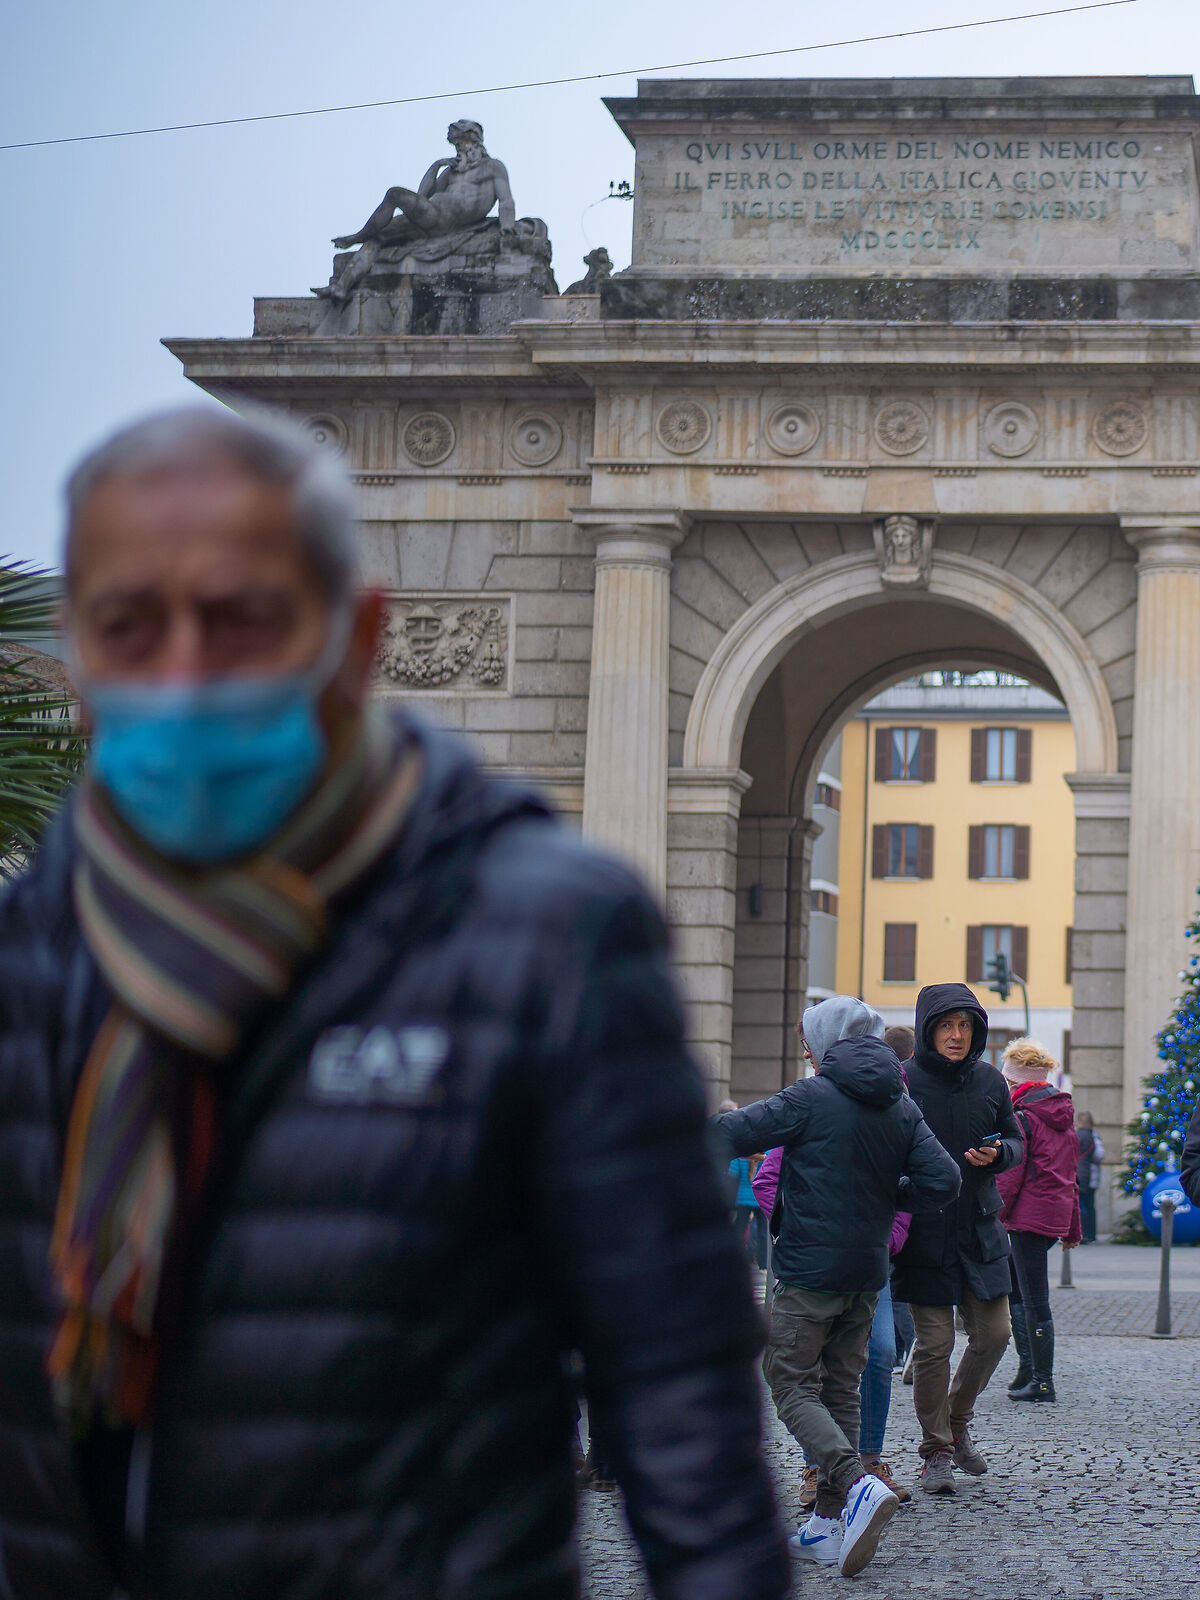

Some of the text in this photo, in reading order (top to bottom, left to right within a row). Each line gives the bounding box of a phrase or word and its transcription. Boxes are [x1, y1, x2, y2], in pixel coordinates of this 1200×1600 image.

[686, 141, 1141, 163] QVI SVLL ORME DEL NOME NEMICO
[674, 170, 1149, 190] IL FERRO DELLA ITALICA GIOVENTV
[721, 201, 1107, 220] INCISE LE VITTORIE COMENSI
[840, 230, 981, 250] MDCCCLIX
